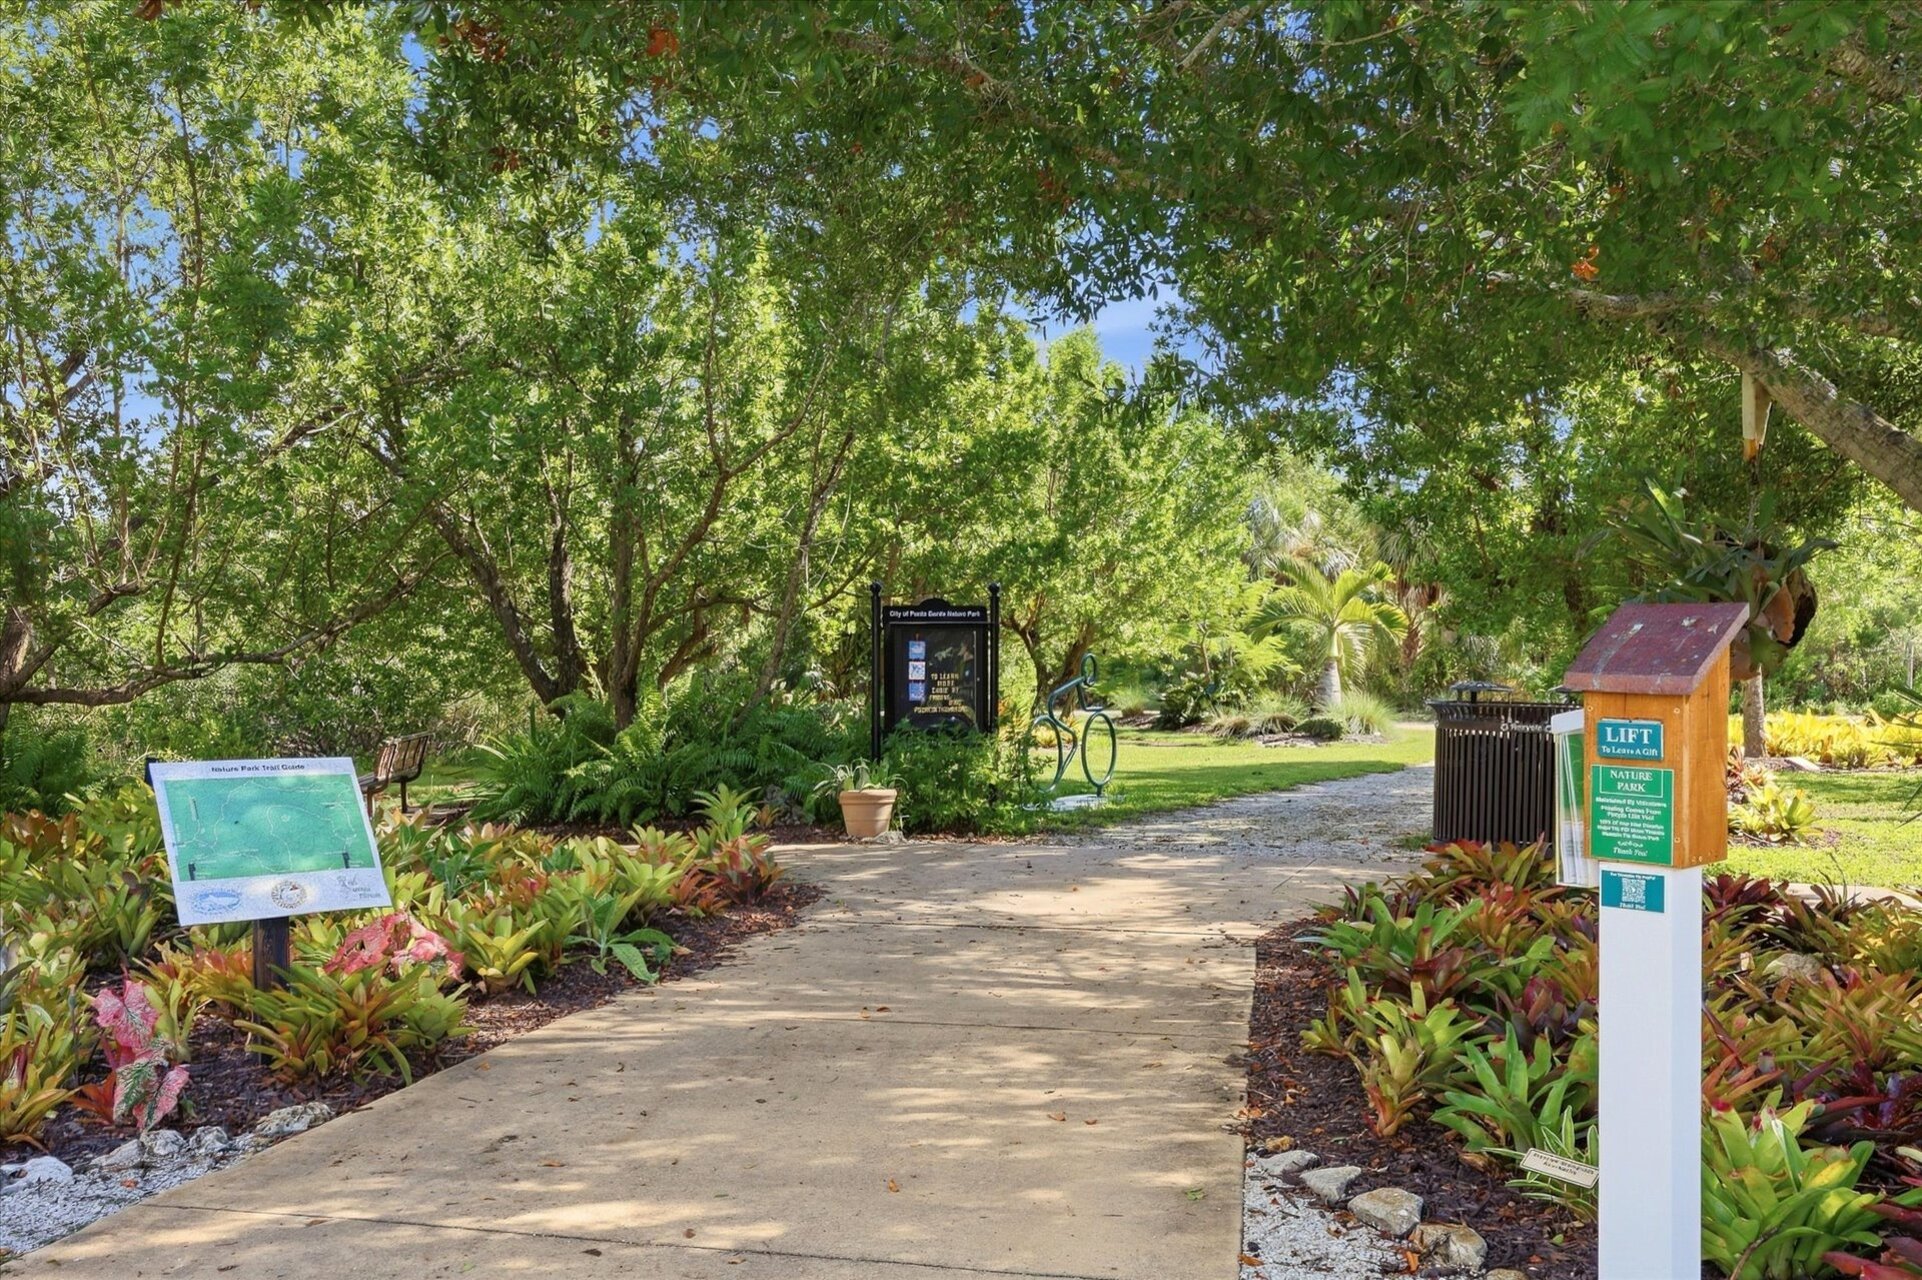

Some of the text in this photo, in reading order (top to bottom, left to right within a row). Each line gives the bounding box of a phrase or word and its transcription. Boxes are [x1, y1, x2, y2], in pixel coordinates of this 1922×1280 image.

[1605, 727, 1653, 745] LIFT
[1602, 745, 1611, 754] To
[1643, 748, 1659, 757] Gift
[1610, 769, 1654, 782] NATURE
[1617, 782, 1646, 793] PARK
[1613, 847, 1633, 855] Thank
